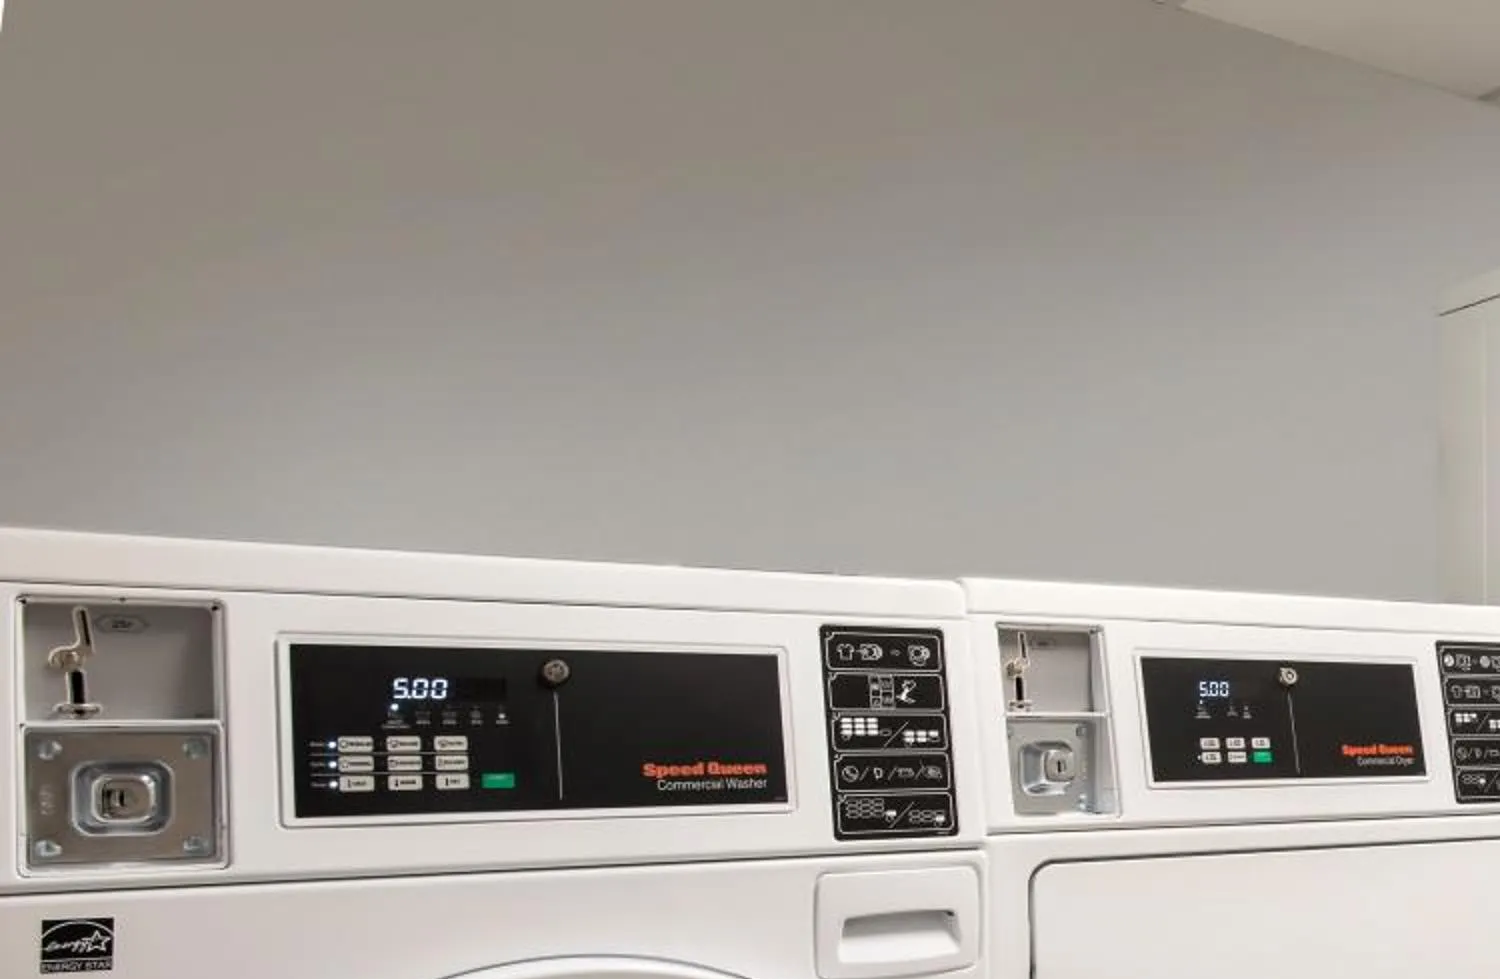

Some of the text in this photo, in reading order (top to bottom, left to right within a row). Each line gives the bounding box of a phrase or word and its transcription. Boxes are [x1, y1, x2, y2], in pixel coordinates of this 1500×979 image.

[393, 678, 448, 699] 5.00
[1199, 681, 1229, 697] 5.00
[1342, 744, 1413, 757] Speed Queen
[643, 761, 767, 778] Speed Queen
[657, 777, 767, 791] Commercial Washer
